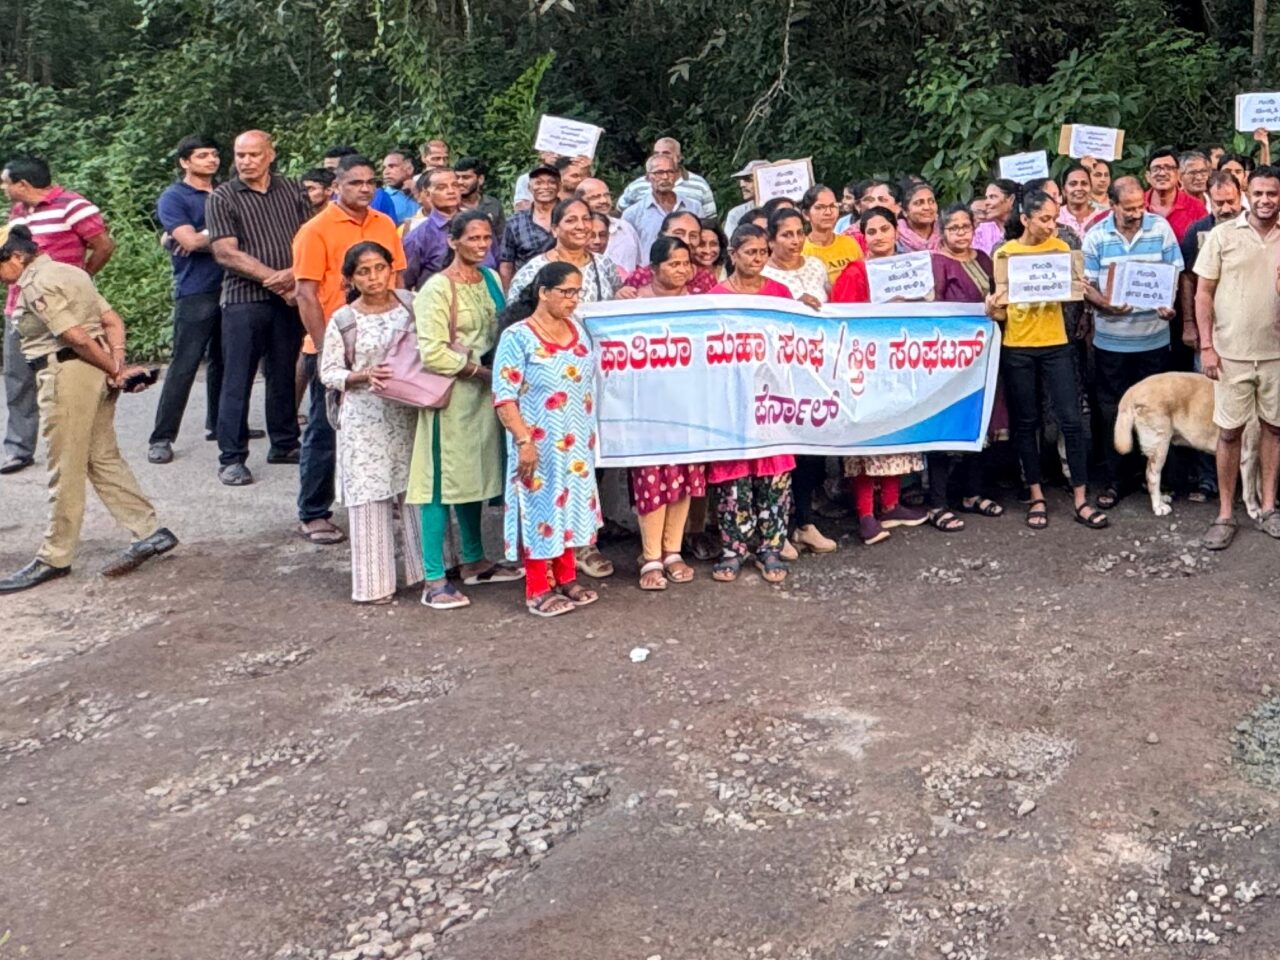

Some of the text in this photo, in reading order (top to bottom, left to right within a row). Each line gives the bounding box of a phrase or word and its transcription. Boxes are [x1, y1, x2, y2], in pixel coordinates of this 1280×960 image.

[600, 328, 692, 377] ಫಾತಿಮಾ
[706, 323, 766, 365] ಮಹಾ
[777, 327, 826, 372] ಸಂಘ
[848, 339, 876, 395] ಸ್ತ್ರೀ
[889, 330, 985, 375] ಸಂಘಟನ್
[755, 383, 840, 427] ಪೆರ್ನಾಲ್
